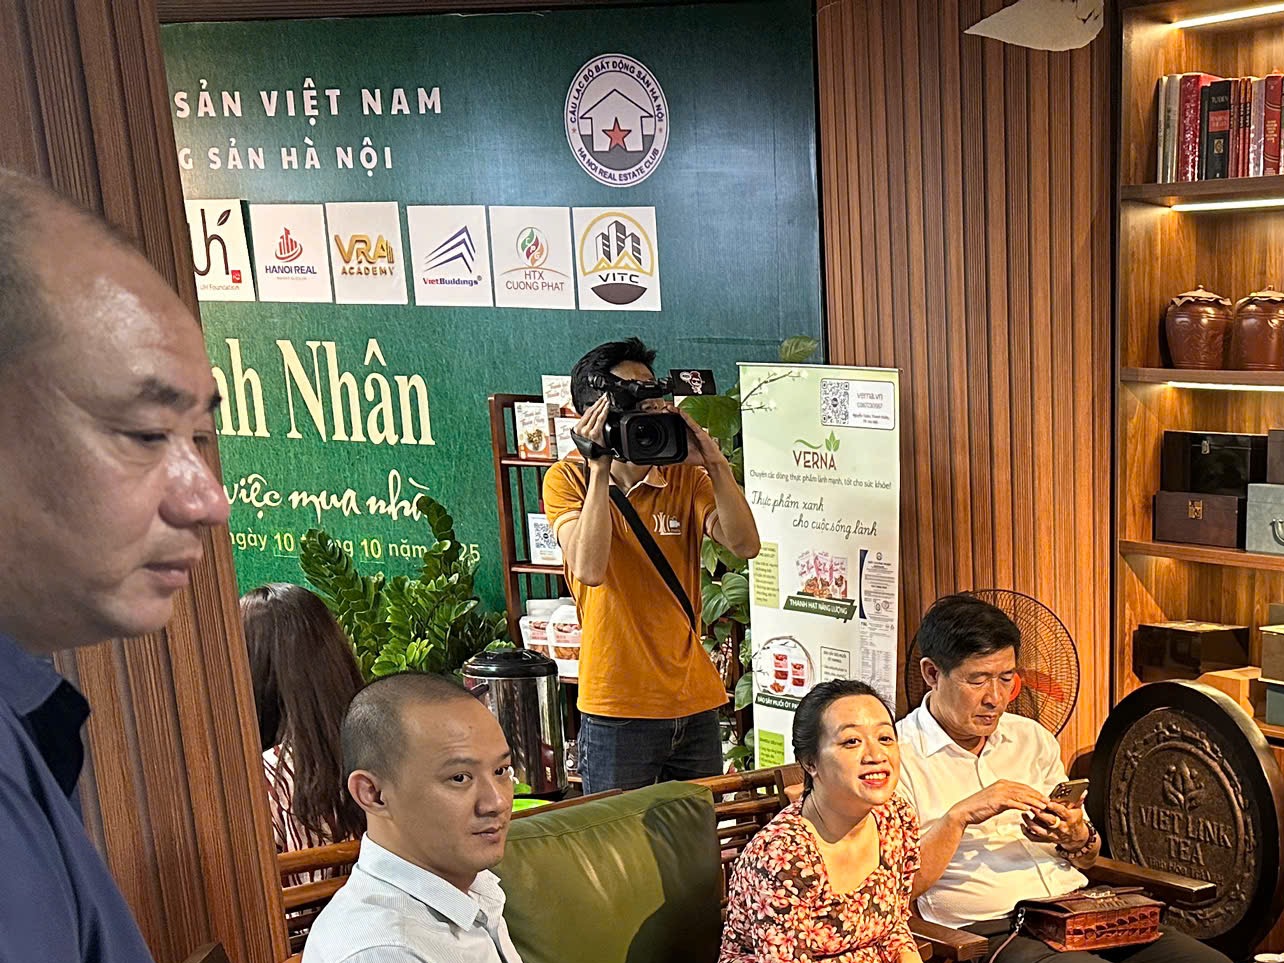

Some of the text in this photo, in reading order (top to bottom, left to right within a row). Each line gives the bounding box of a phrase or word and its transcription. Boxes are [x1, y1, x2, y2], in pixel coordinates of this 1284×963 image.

[174, 77, 441, 126] SẢN VIỆT NAM
[207, 138, 265, 170] SẢN
[281, 136, 320, 169] HÀ
[336, 136, 393, 177] NỘI
[598, 168, 617, 181] REAL
[619, 166, 645, 181] ESTATE
[645, 147, 659, 169] CLUB
[265, 265, 317, 275] HANOI REAL
[341, 267, 395, 276] ACADEMY
[524, 270, 545, 280] HTX
[598, 272, 640, 284] VITC
[505, 280, 564, 291] CUONG PHAT
[276, 338, 435, 446] Nhân
[793, 450, 837, 471] VERNA
[288, 488, 361, 523] mua
[772, 493, 799, 513] phẩm
[802, 497, 824, 511] xanh
[793, 513, 809, 528] cho
[830, 518, 852, 540] sống
[852, 520, 877, 536] lành
[274, 533, 295, 552] 10
[361, 538, 382, 559] 10
[1167, 835, 1205, 866] TEA
